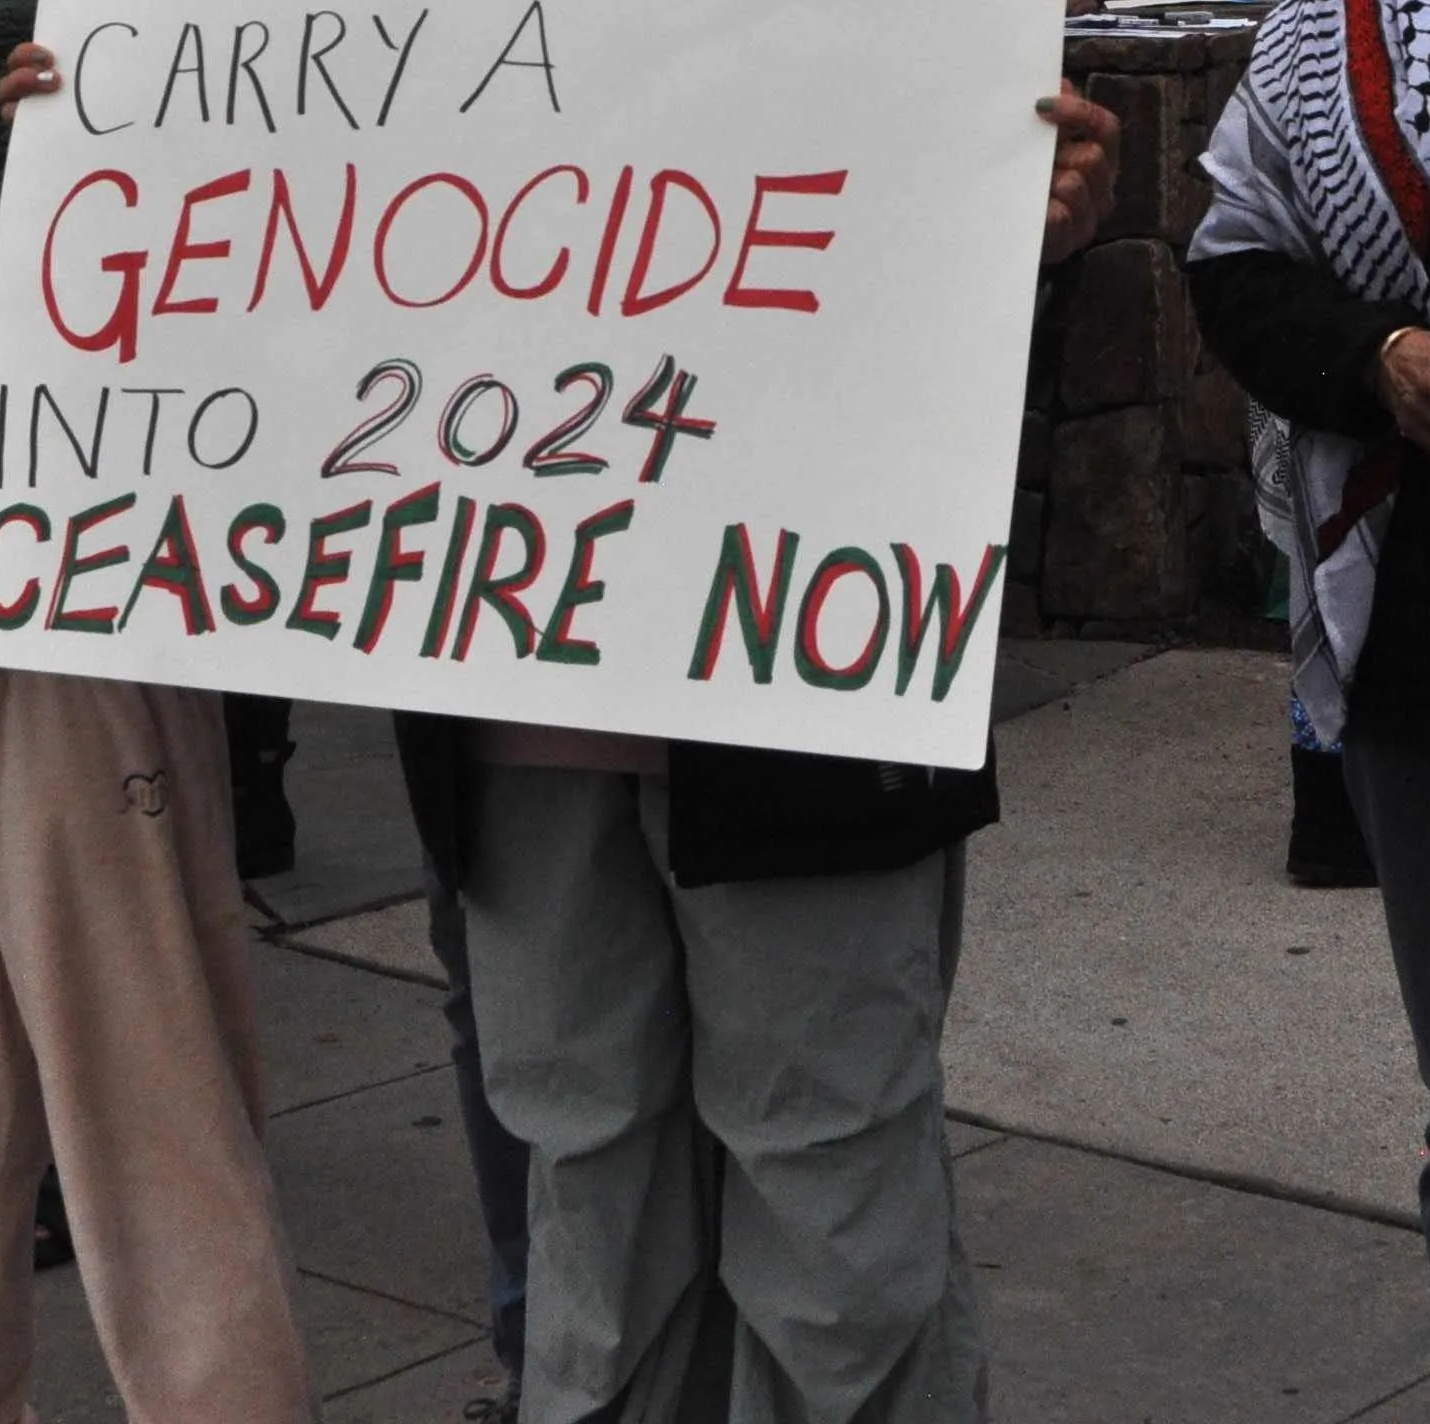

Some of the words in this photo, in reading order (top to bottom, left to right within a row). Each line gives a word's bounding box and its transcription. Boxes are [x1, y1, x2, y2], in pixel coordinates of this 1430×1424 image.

[72, 6, 429, 137] CARRY
[40, 162, 850, 366] GENOCIDE
[320, 353, 719, 485] 2024
[687, 522, 1010, 705] NOW
